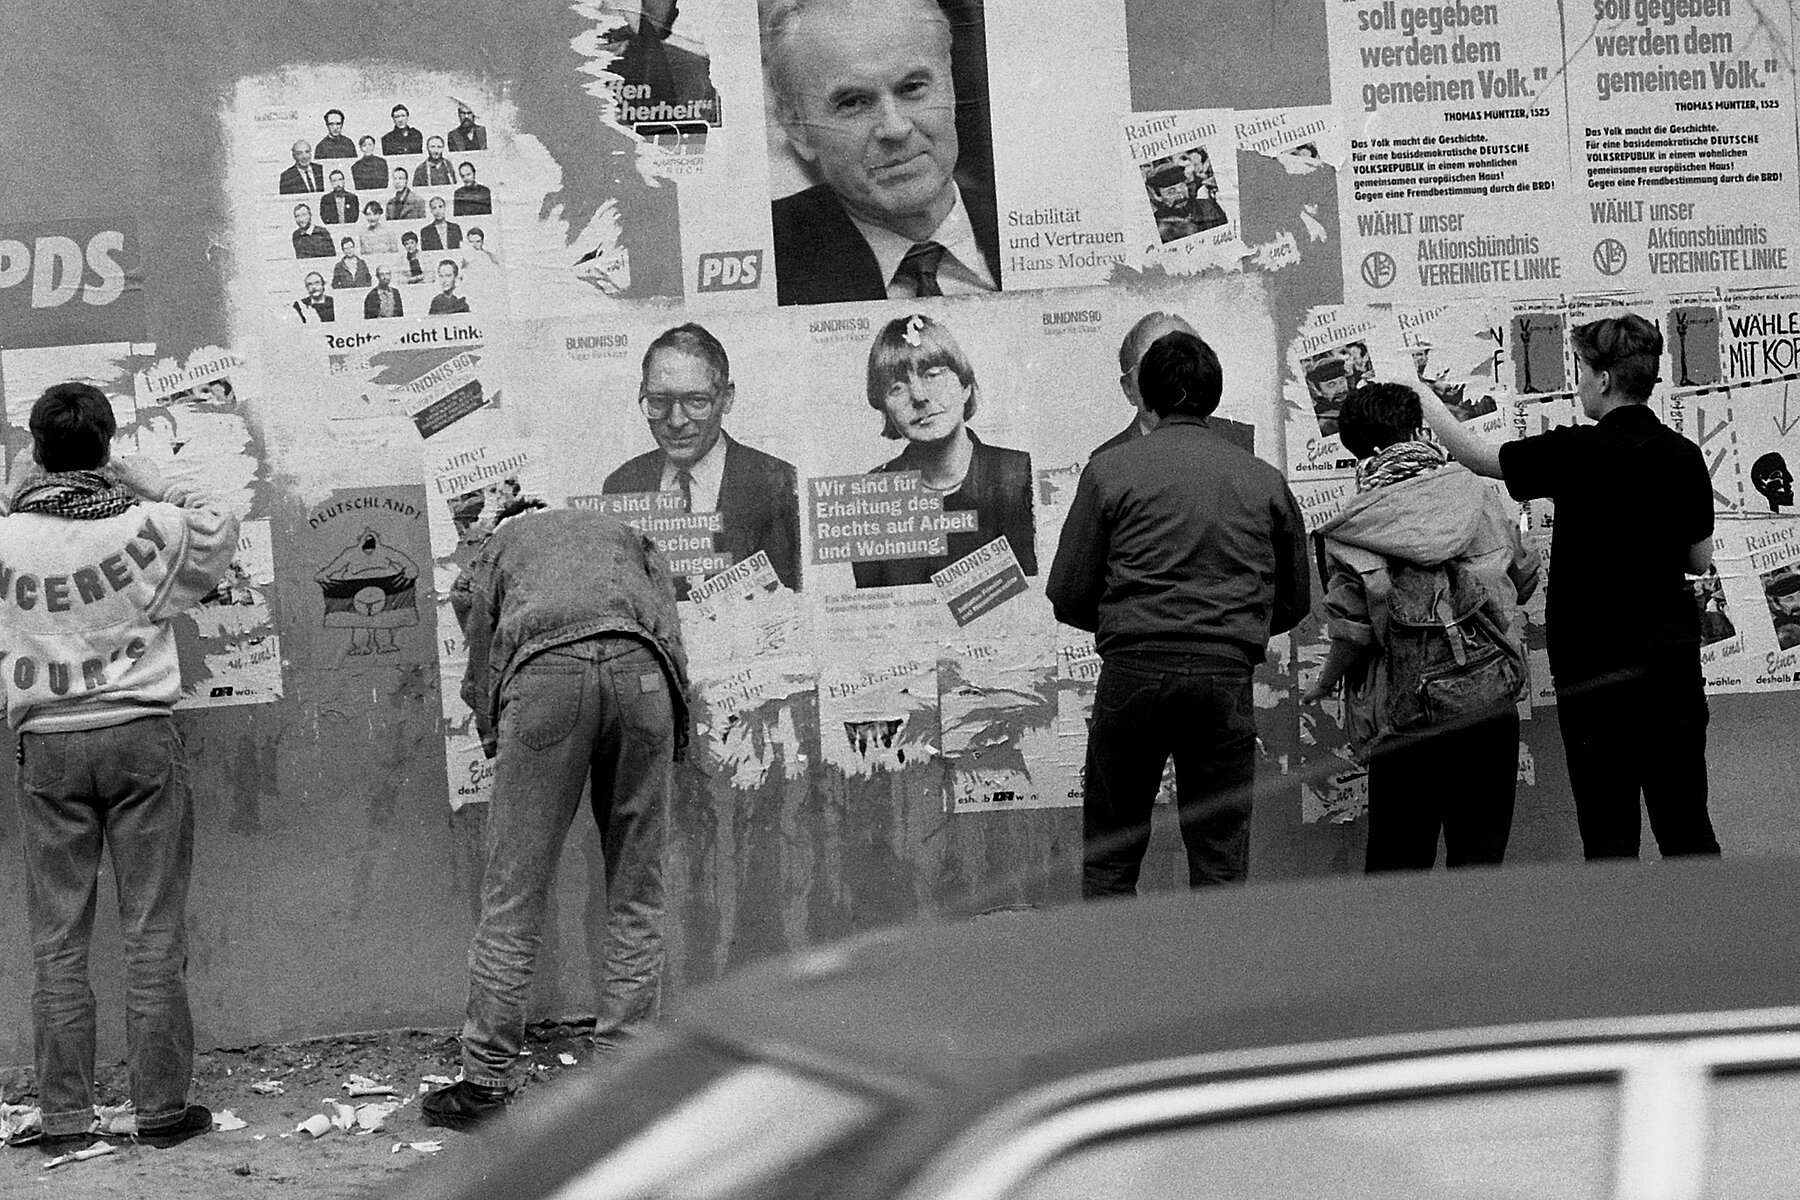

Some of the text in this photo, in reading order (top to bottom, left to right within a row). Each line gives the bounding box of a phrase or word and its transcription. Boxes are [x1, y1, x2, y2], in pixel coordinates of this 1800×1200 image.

[1358, 0, 1498, 36] soll gegeben
[1360, 35, 1501, 68] werden dem
[1595, 26, 1732, 57] werden dem
[1363, 67, 1548, 112] gemeinen Volk."
[1597, 59, 1778, 101] gemeinen Volk."
[1444, 111, 1482, 121] THOMAS
[1530, 108, 1550, 117] 1525
[1675, 101, 1713, 111] THOMAS
[1761, 100, 1779, 109] 1525
[1125, 115, 1177, 141] Rainer
[1234, 113, 1287, 139] Rainer
[1585, 124, 1719, 136] Das Volk macht die Geschichte.
[1129, 123, 1217, 159] Eppelmann
[1352, 134, 1489, 149] Das Volk macht die Geschichte.
[1586, 135, 1759, 149] Für eine basisdemokratische DEUTSCHE
[1352, 144, 1530, 162] Für eine basisdemokratische DEUTSCHE
[1587, 148, 1748, 162] VOLKSREPUBLIK in einem wohnlichen
[1353, 158, 1518, 175] VOLKSREPUBLIK in einem wohnlichen
[1587, 161, 1734, 177] gemeinsamen europäischen Haus!
[1354, 171, 1505, 190] gemeinsamen europäischen Haus!
[1354, 180, 1555, 202] Gegen eine Fremdbestimmung durch die BRD!
[1588, 172, 1782, 190] Gegen eine Fremdbestimmung durch die BRD!
[1008, 208, 1081, 227] Stabilität
[1590, 198, 1695, 224] WÄHLT unser
[1357, 210, 1464, 236] WÄHLT unser
[1010, 231, 1124, 249] und Vertrauen
[1648, 223, 1767, 249] Aktionsbündnis
[1417, 233, 1540, 261] Aktionsbündnis
[703, 255, 757, 286] PDS
[1011, 256, 1053, 271] Hans
[1418, 257, 1561, 287] VEREINIGTE LINKE
[1650, 248, 1788, 275] VEREINIGTE LINKE
[444, 325, 483, 341] Link
[1296, 463, 1333, 472] deshalb
[815, 474, 918, 497] Wir sind für
[309, 496, 422, 530] DEUTSCHLAND!
[574, 497, 606, 512] Wir
[612, 494, 650, 512] sind
[816, 496, 940, 518] Erhaltung des
[817, 513, 975, 539] Rechts auf Arbeit
[653, 536, 712, 552] schen
[818, 536, 946, 560] und Wohnung.
[990, 538, 1008, 556] 90
[1746, 527, 1795, 551] Rainer
[750, 552, 769, 573] 90
[1708, 676, 1742, 686] wählen
[1756, 674, 1791, 684] deshalb
